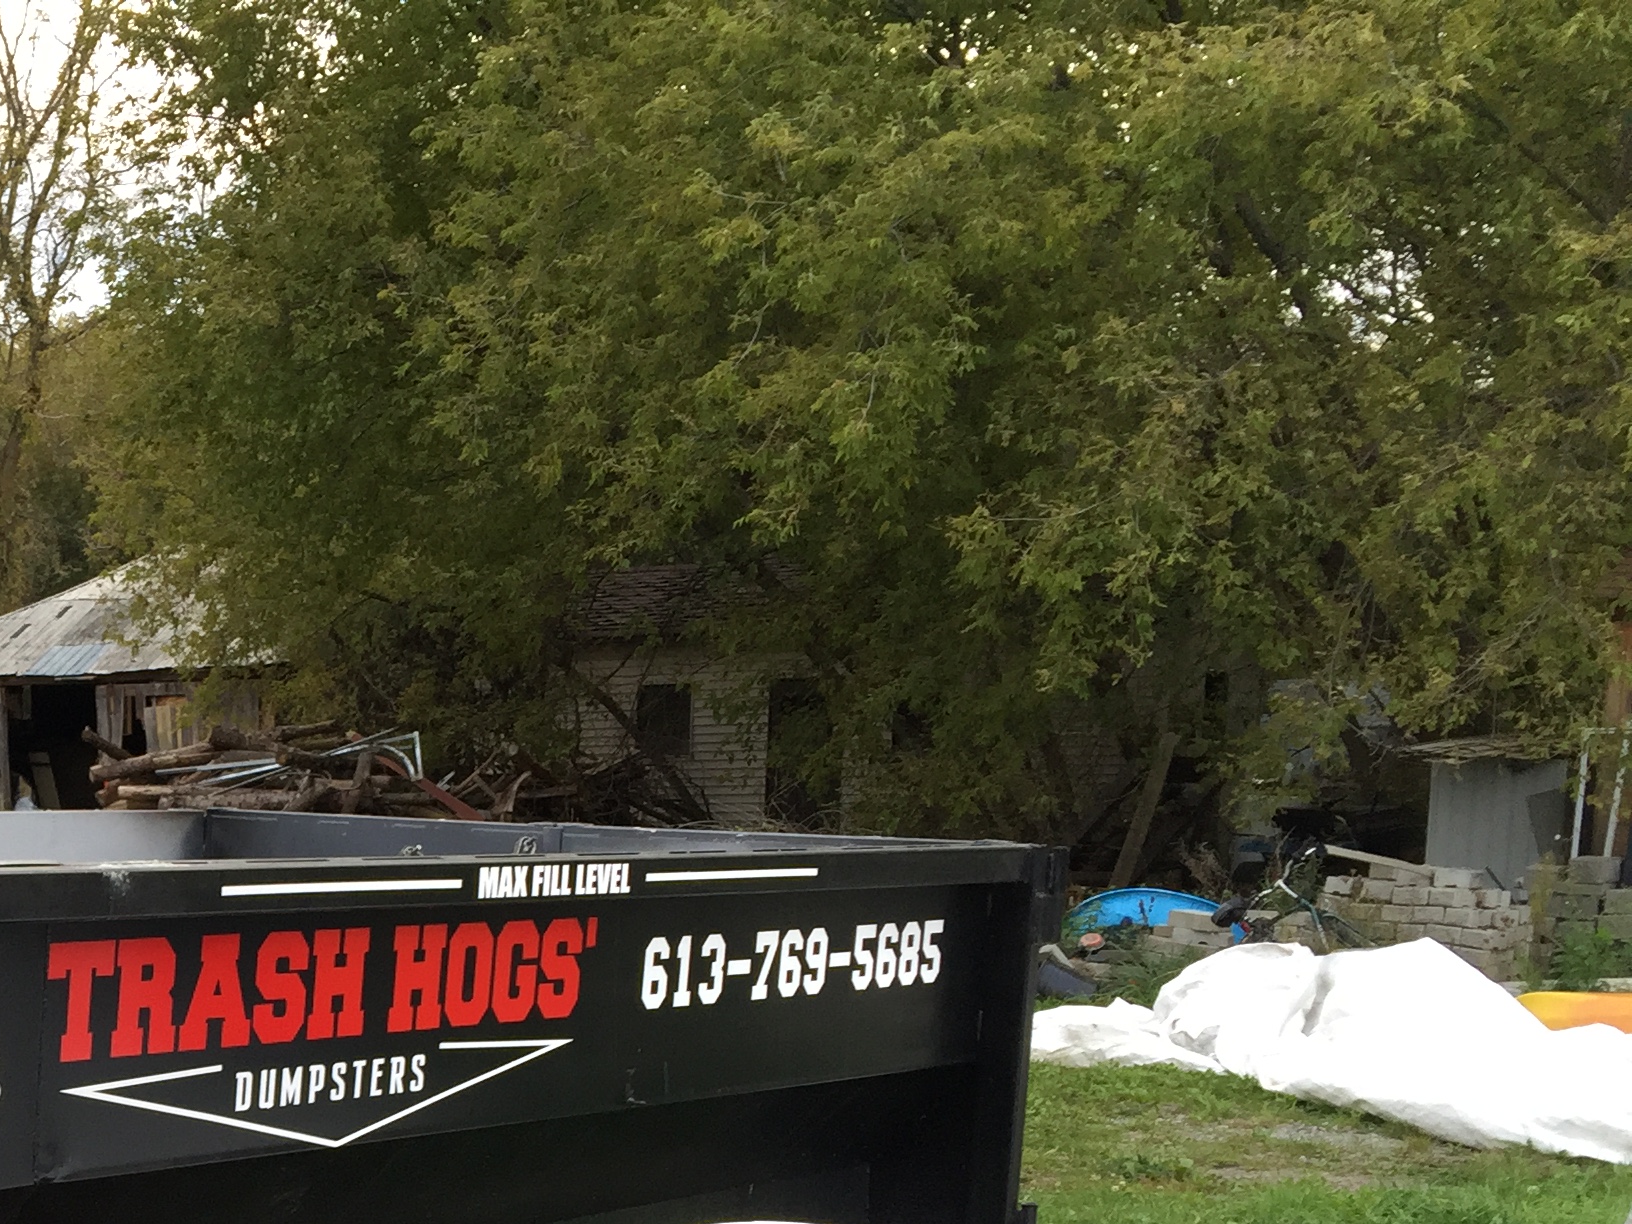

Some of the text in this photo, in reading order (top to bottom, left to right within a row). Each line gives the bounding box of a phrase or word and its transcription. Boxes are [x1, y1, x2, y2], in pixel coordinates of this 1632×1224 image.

[478, 863, 631, 899] MAX FILL LEVEL
[47, 917, 598, 1063] TRASH HOGS'
[641, 919, 945, 1010] 613-769-5685
[234, 1054, 427, 1112] DUMPSTERS
